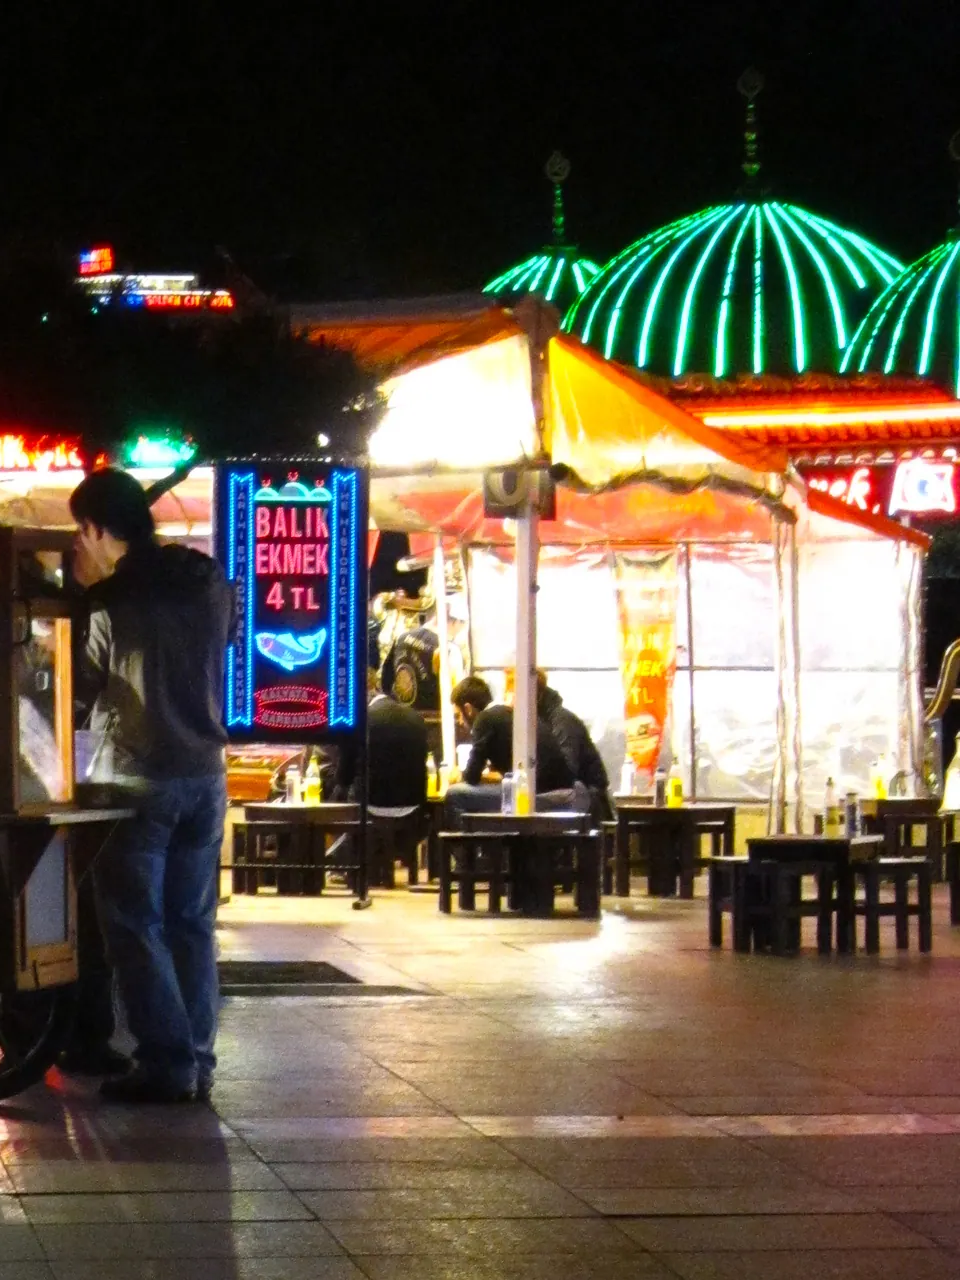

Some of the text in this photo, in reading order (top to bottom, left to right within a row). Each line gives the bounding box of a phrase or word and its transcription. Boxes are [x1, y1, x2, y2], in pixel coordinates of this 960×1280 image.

[255, 506, 329, 538] BALIK
[255, 543, 329, 575] EKMEK
[266, 581, 320, 611] 4 TL
